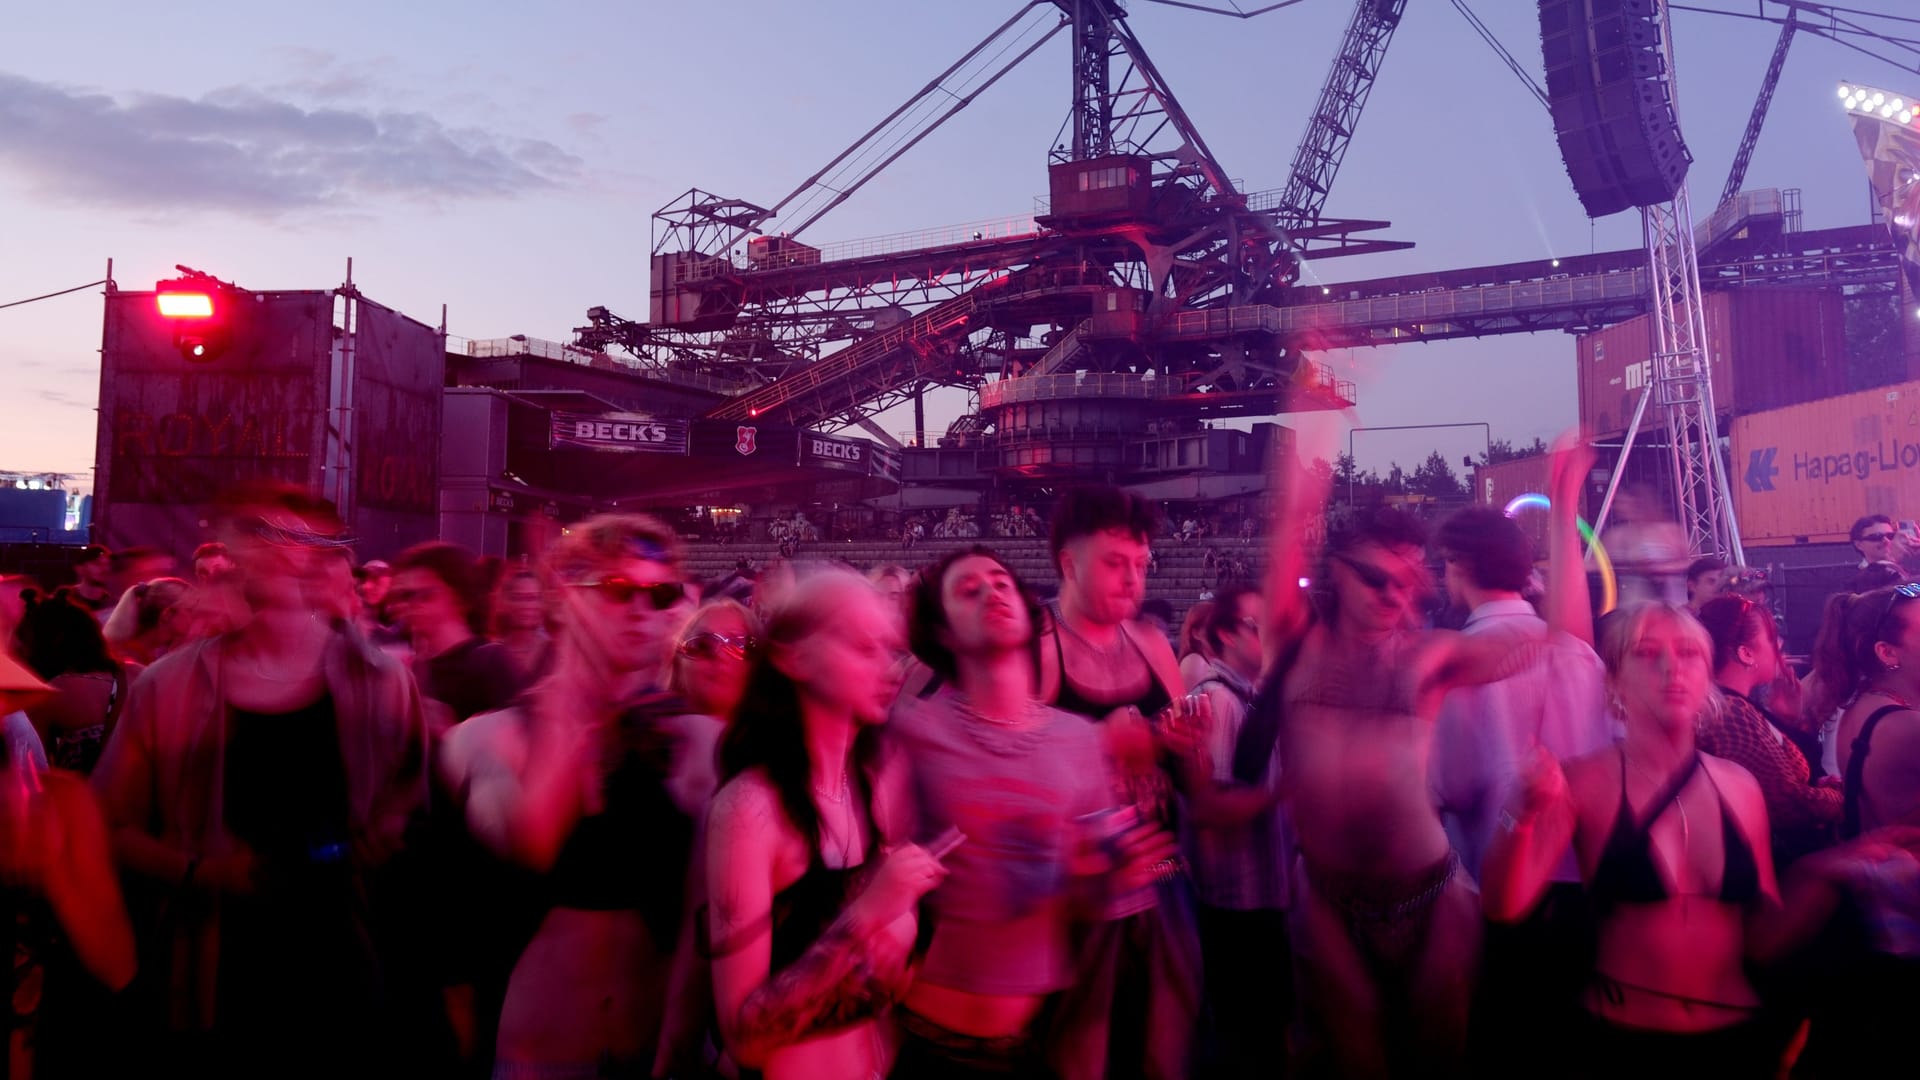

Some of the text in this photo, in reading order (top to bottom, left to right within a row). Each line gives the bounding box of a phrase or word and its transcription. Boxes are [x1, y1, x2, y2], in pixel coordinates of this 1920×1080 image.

[117, 412, 309, 457] ROYAL
[576, 421, 667, 442] BECK'S
[812, 440, 861, 460] BECK'S
[1793, 438, 1920, 485] Hapag-Llo
